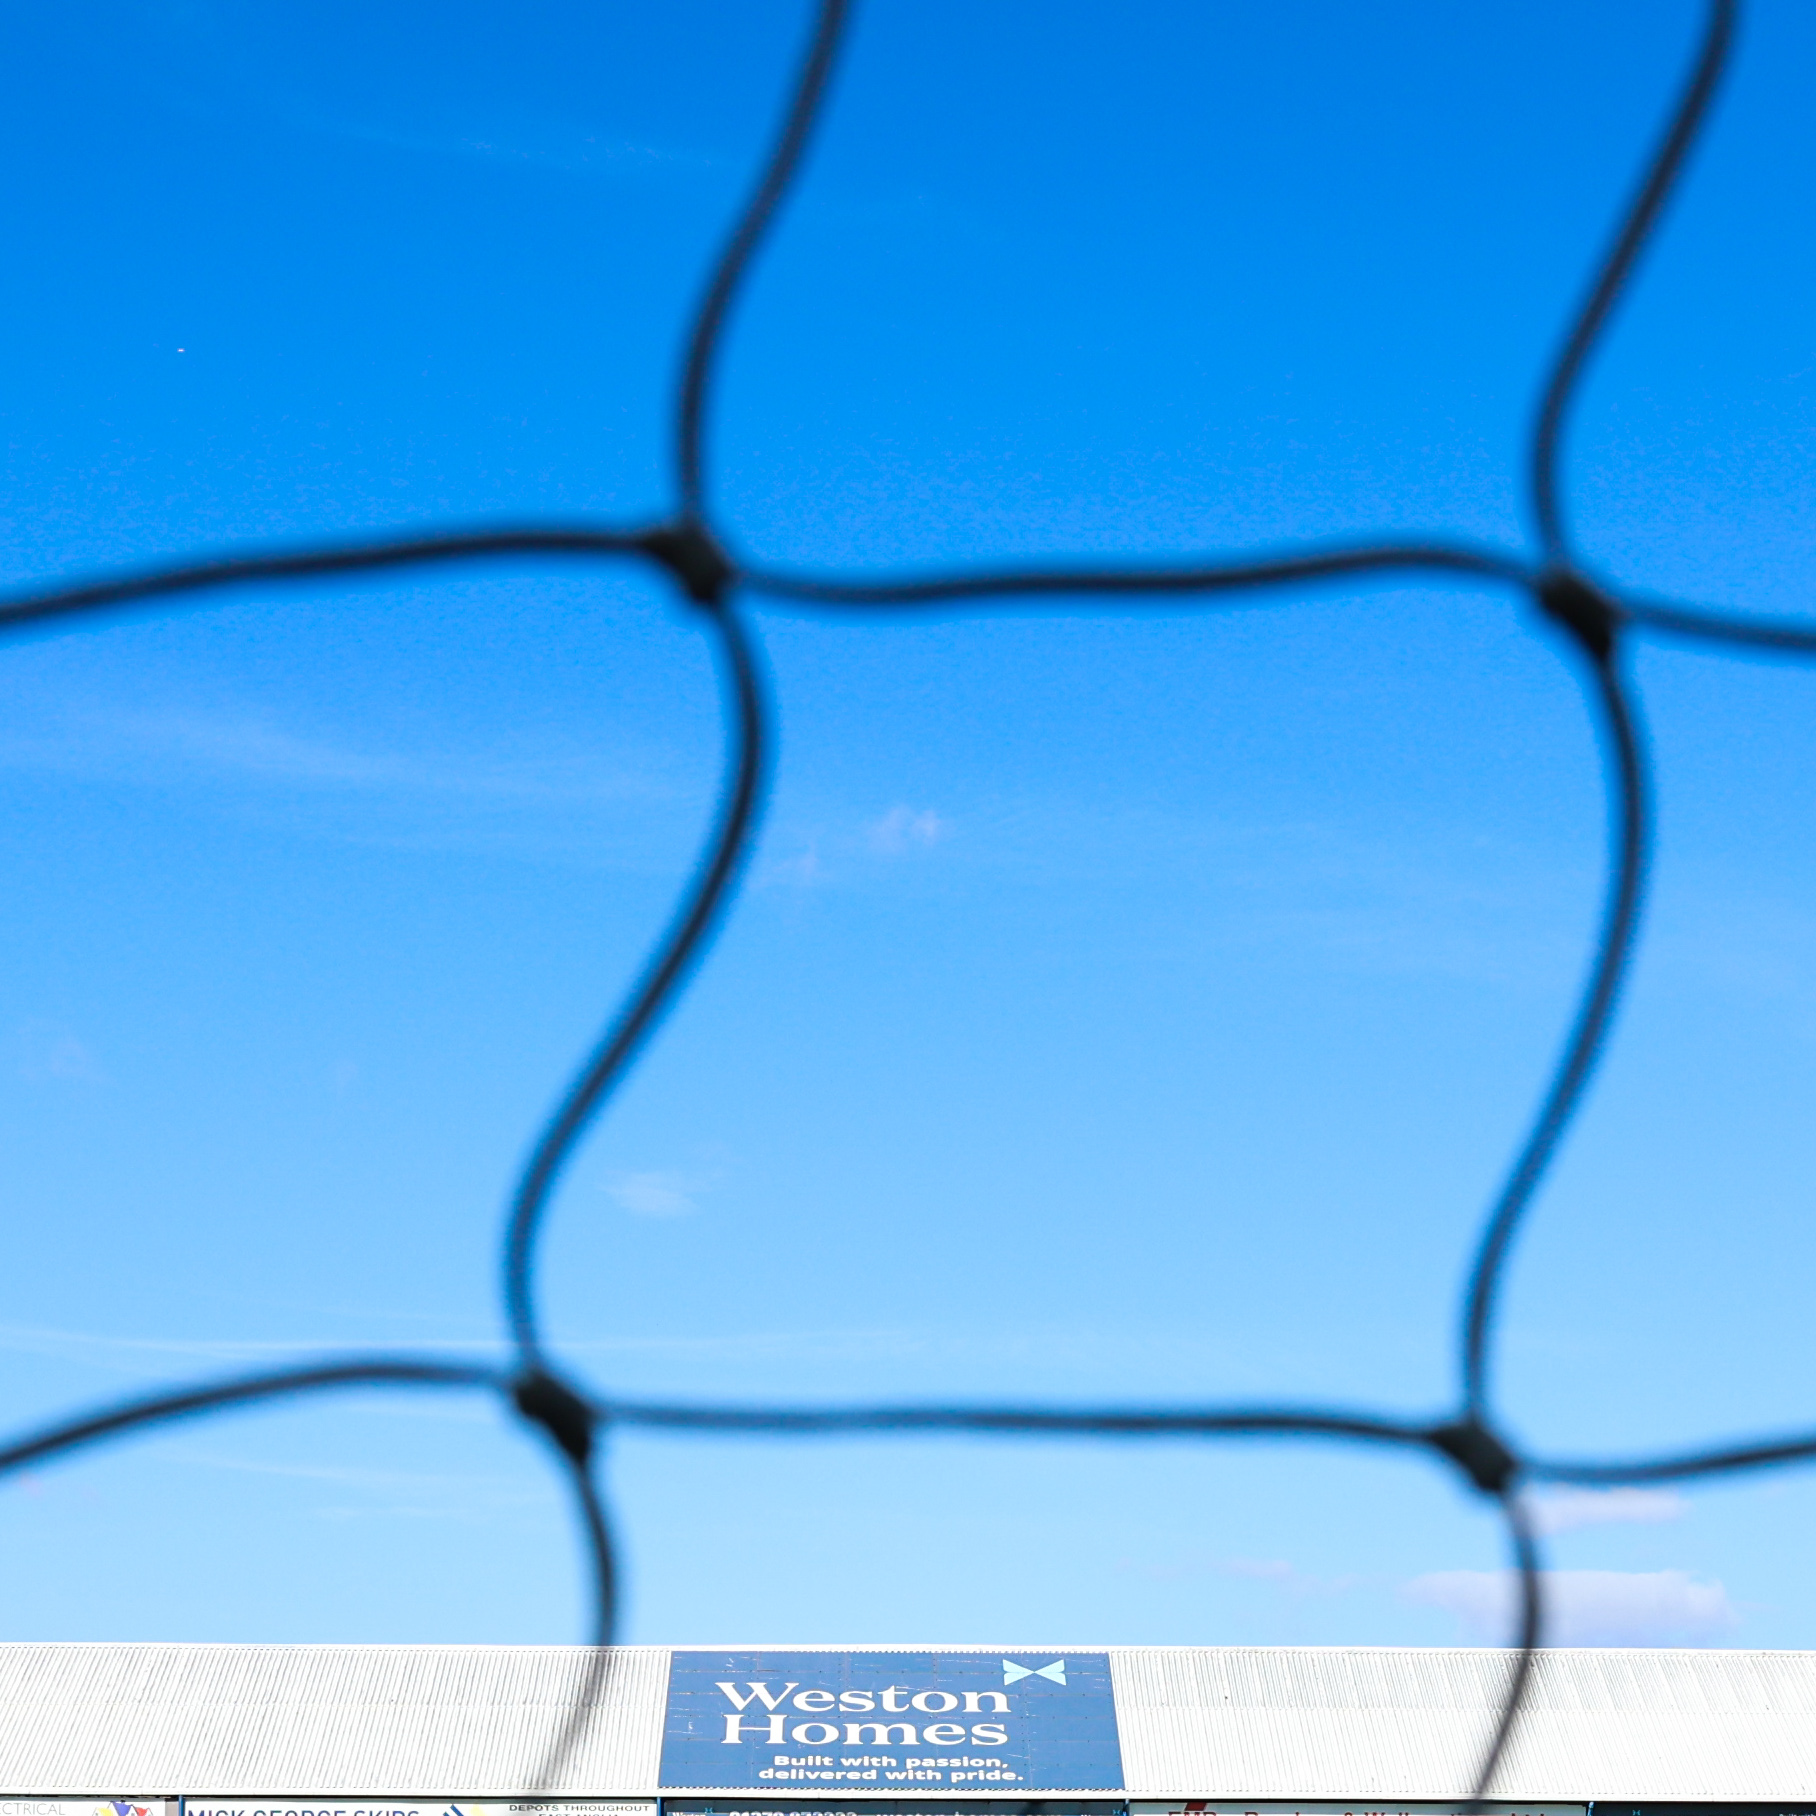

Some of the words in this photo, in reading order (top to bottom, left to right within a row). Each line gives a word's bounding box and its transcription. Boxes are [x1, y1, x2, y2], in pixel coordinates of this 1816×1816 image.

[715, 1682, 1012, 1713] Weston
[720, 1714, 1009, 1745] Homes
[774, 1756, 834, 1767] Built
[841, 1756, 897, 1767] with
[906, 1757, 1008, 1770] passion,
[759, 1768, 877, 1781] delivered
[886, 1769, 942, 1781] with
[951, 1769, 1024, 1783] pride.
[509, 1804, 559, 1812] DEPOTS
[563, 1804, 650, 1812] THROUGHOUT
